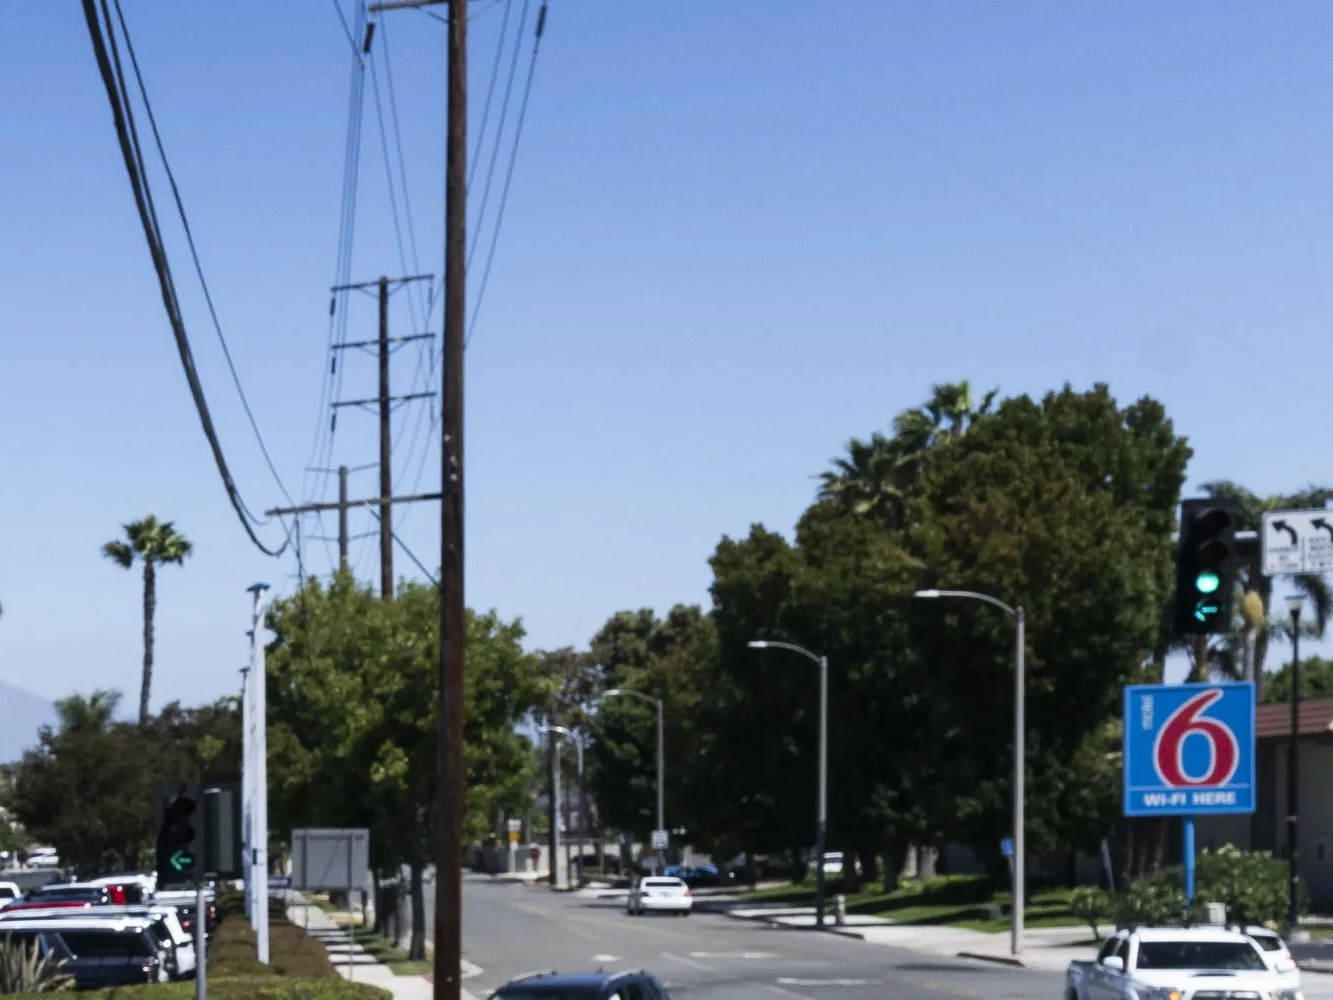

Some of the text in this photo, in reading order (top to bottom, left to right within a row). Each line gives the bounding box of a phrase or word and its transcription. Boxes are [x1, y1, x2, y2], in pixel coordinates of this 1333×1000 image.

[1153, 687, 1240, 788] 6
[1143, 791, 1237, 806] WI-FI HERE
